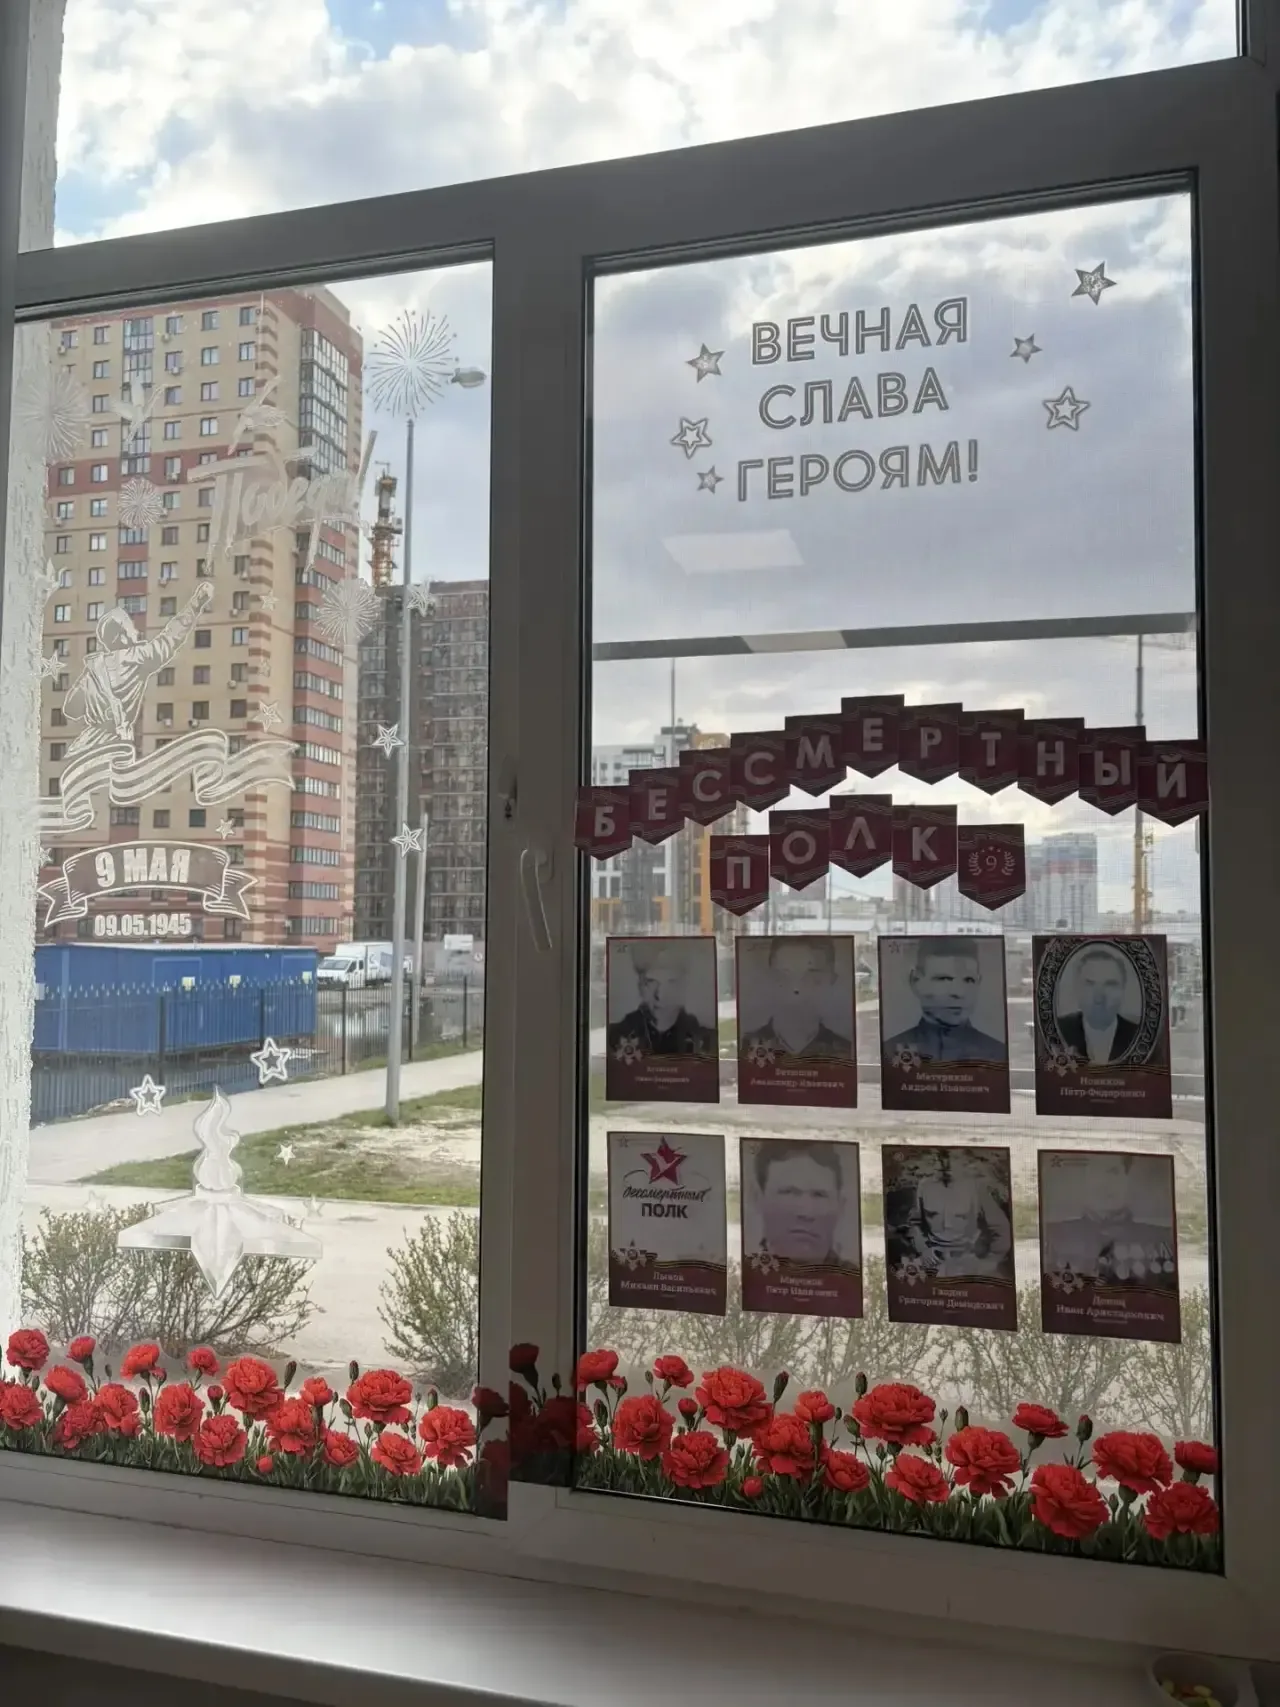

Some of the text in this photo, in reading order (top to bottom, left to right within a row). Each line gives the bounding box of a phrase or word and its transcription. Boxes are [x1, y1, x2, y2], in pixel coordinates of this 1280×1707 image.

[751, 297, 969, 365] ВЕЧНАЯ
[759, 367, 949, 429] СЛАВА
[737, 439, 979, 502] ГЕРОЯМ!
[594, 717, 1187, 838] БЕССМЕРТНЫЙ
[95, 848, 191, 888] 9 МАЯ
[726, 816, 938, 890] ПОЛК
[94, 913, 192, 937] 09.05.1945
[642, 1203, 689, 1219] ПОЛК
[620, 1280, 659, 1291] Михаил
